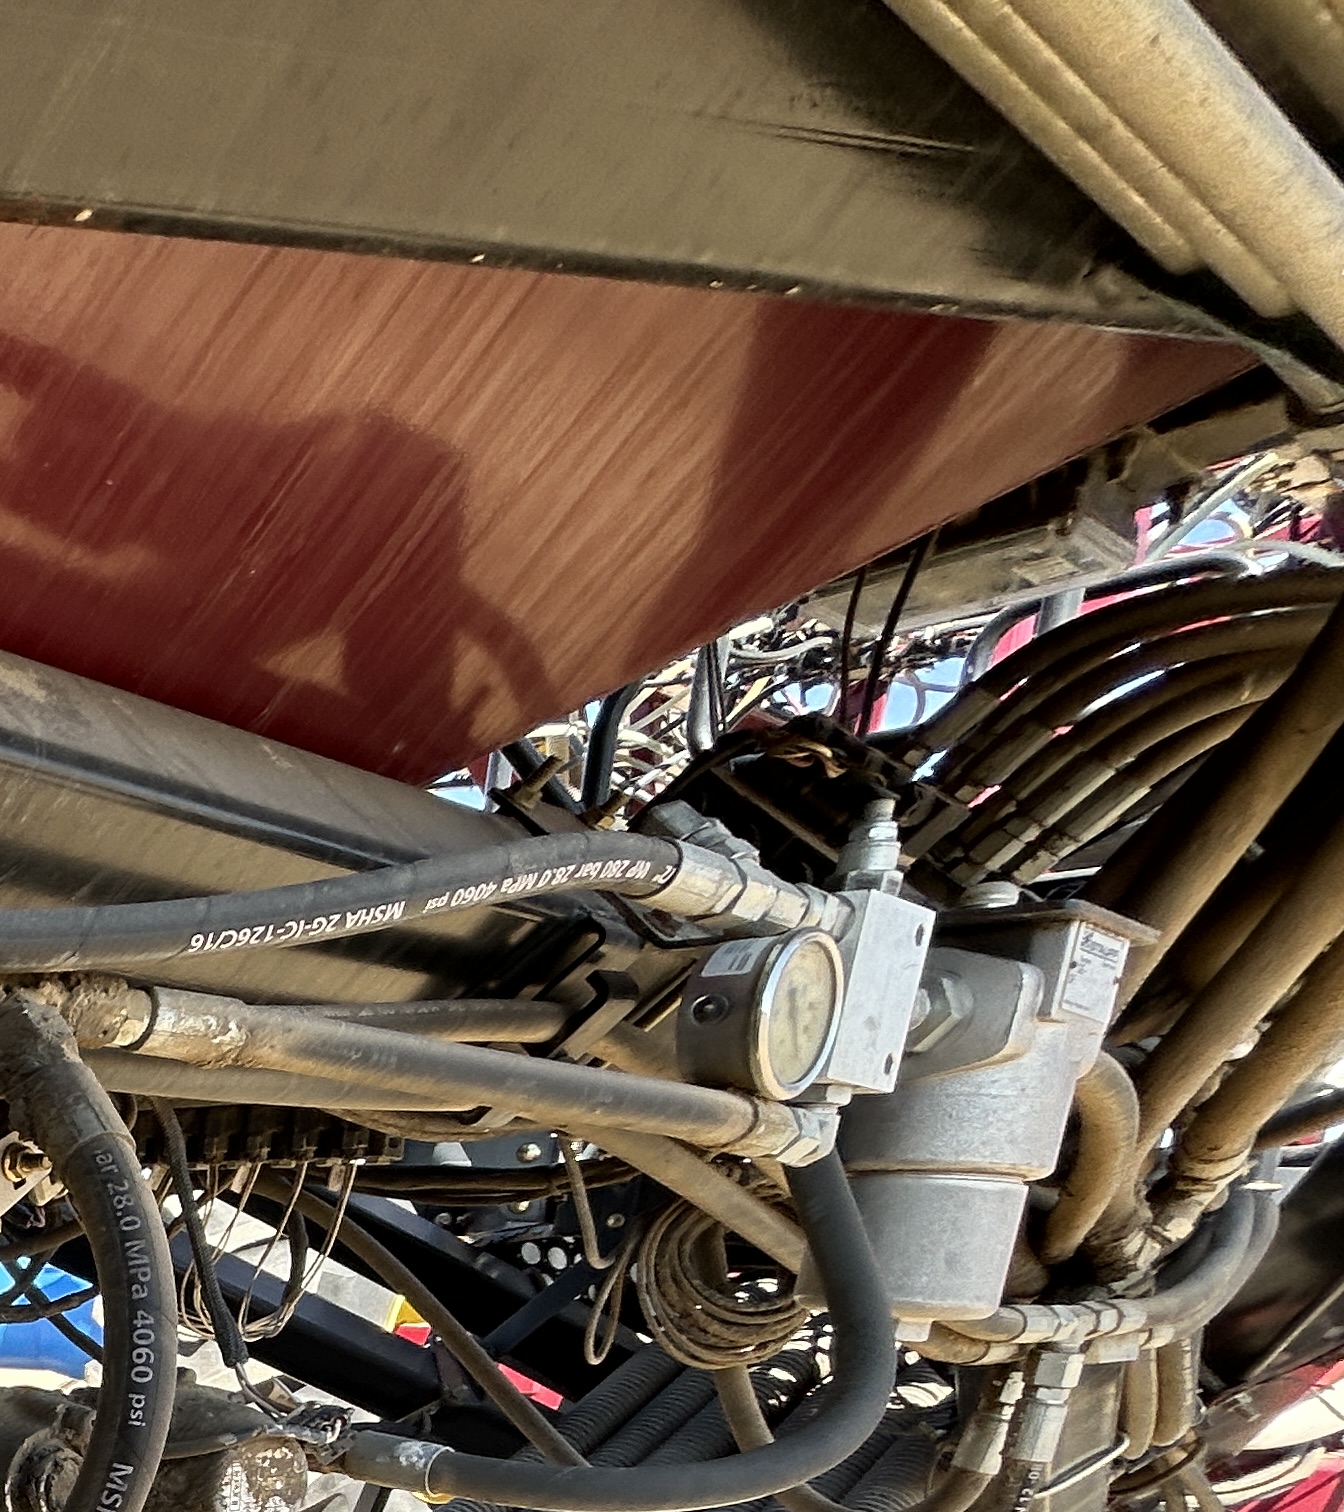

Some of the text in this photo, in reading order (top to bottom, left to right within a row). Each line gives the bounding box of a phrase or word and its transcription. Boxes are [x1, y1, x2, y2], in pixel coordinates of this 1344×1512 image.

[536, 864, 577, 888] 28.0
[575, 860, 602, 880] bar
[600, 859, 631, 880] 280
[625, 859, 652, 880] WP
[449, 882, 498, 908] 4060
[500, 872, 540, 895] MPa
[345, 900, 407, 930] MSHA
[422, 892, 450, 914] psi
[188, 912, 342, 953] 2G-IC-126C/16
[107, 1178, 142, 1233] 28.0
[123, 1238, 152, 1301] MPa
[130, 1309, 156, 1384] 4060
[128, 1391, 147, 1428] psi
